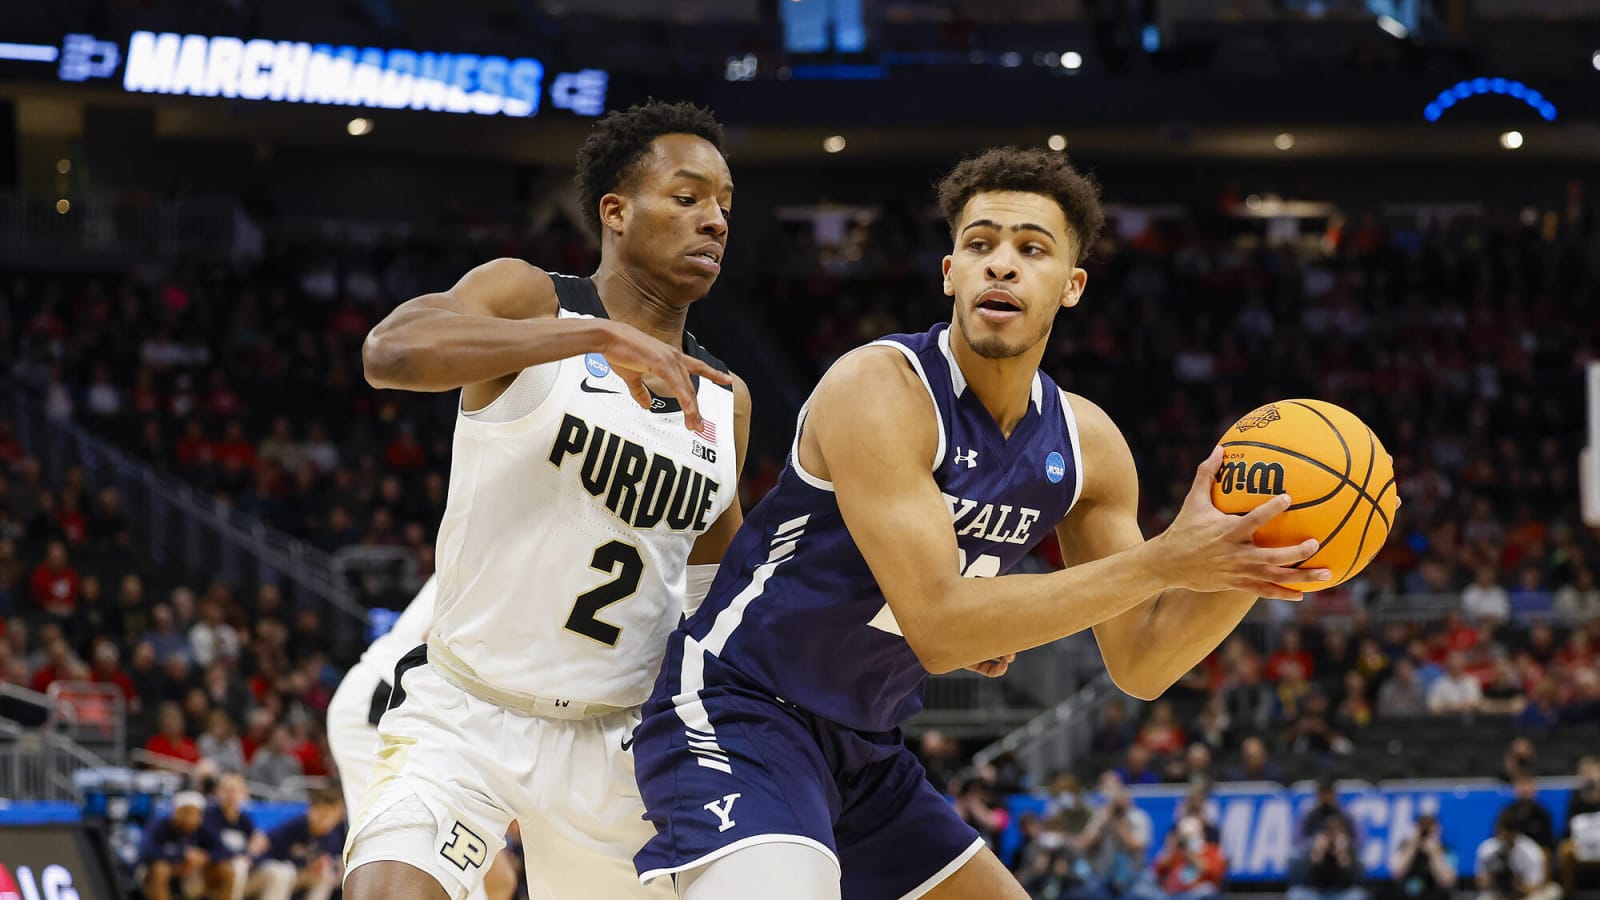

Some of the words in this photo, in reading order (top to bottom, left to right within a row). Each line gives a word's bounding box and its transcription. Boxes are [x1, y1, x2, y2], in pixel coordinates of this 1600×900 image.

[548, 412, 722, 532] PURDUE
[931, 491, 1041, 545] YALE
[562, 539, 647, 650] 2
[703, 792, 742, 833] Y
[440, 820, 488, 871] P
